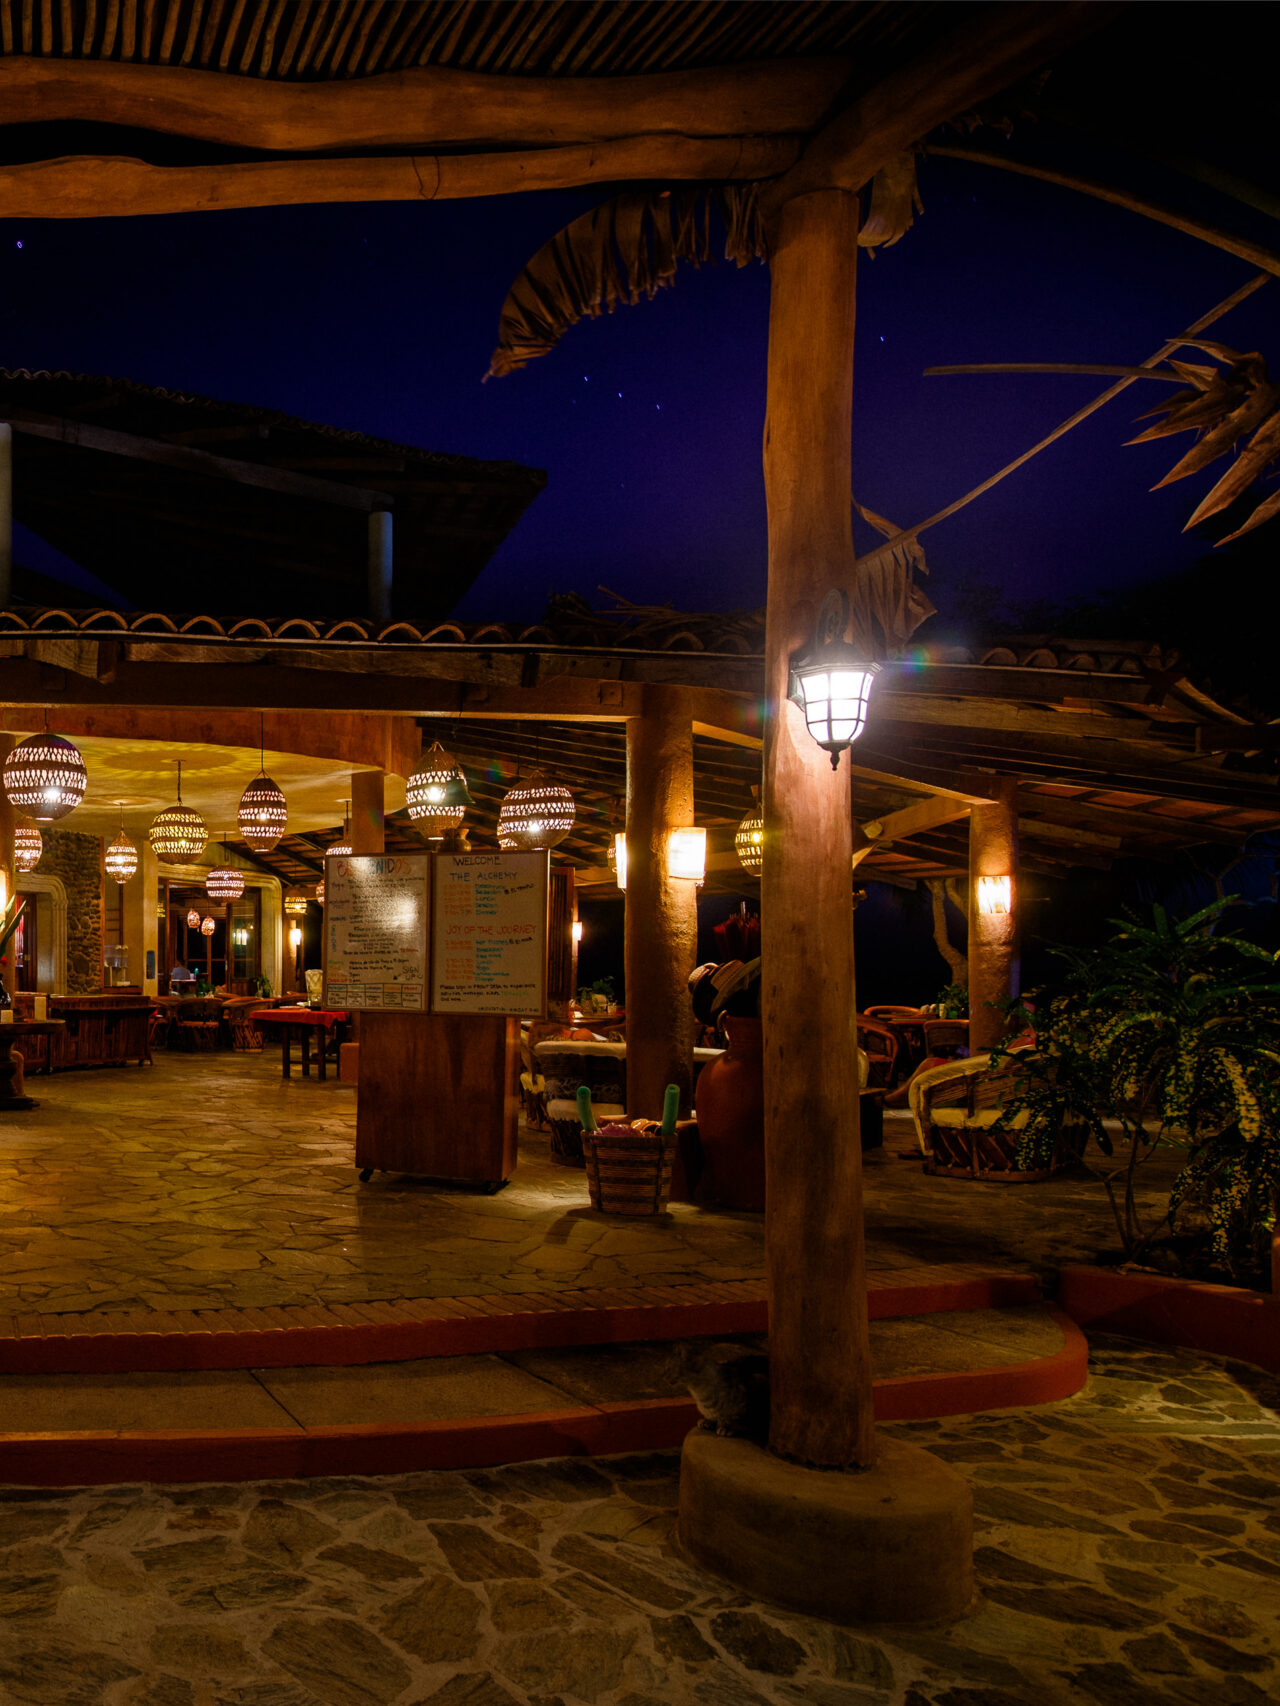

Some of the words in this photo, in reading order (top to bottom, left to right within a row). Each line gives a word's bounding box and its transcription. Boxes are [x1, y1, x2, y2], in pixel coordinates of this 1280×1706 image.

[453, 856, 502, 866] WELCOME
[337, 857, 411, 877] BIENIDOS
[449, 872, 471, 882] THE
[477, 871, 518, 881] ALCHEMY
[447, 924, 461, 935] JOY
[464, 924, 476, 935] OF
[477, 924, 493, 936] THE
[496, 924, 536, 935] JOURNEY
[402, 965, 420, 974] SIGN
